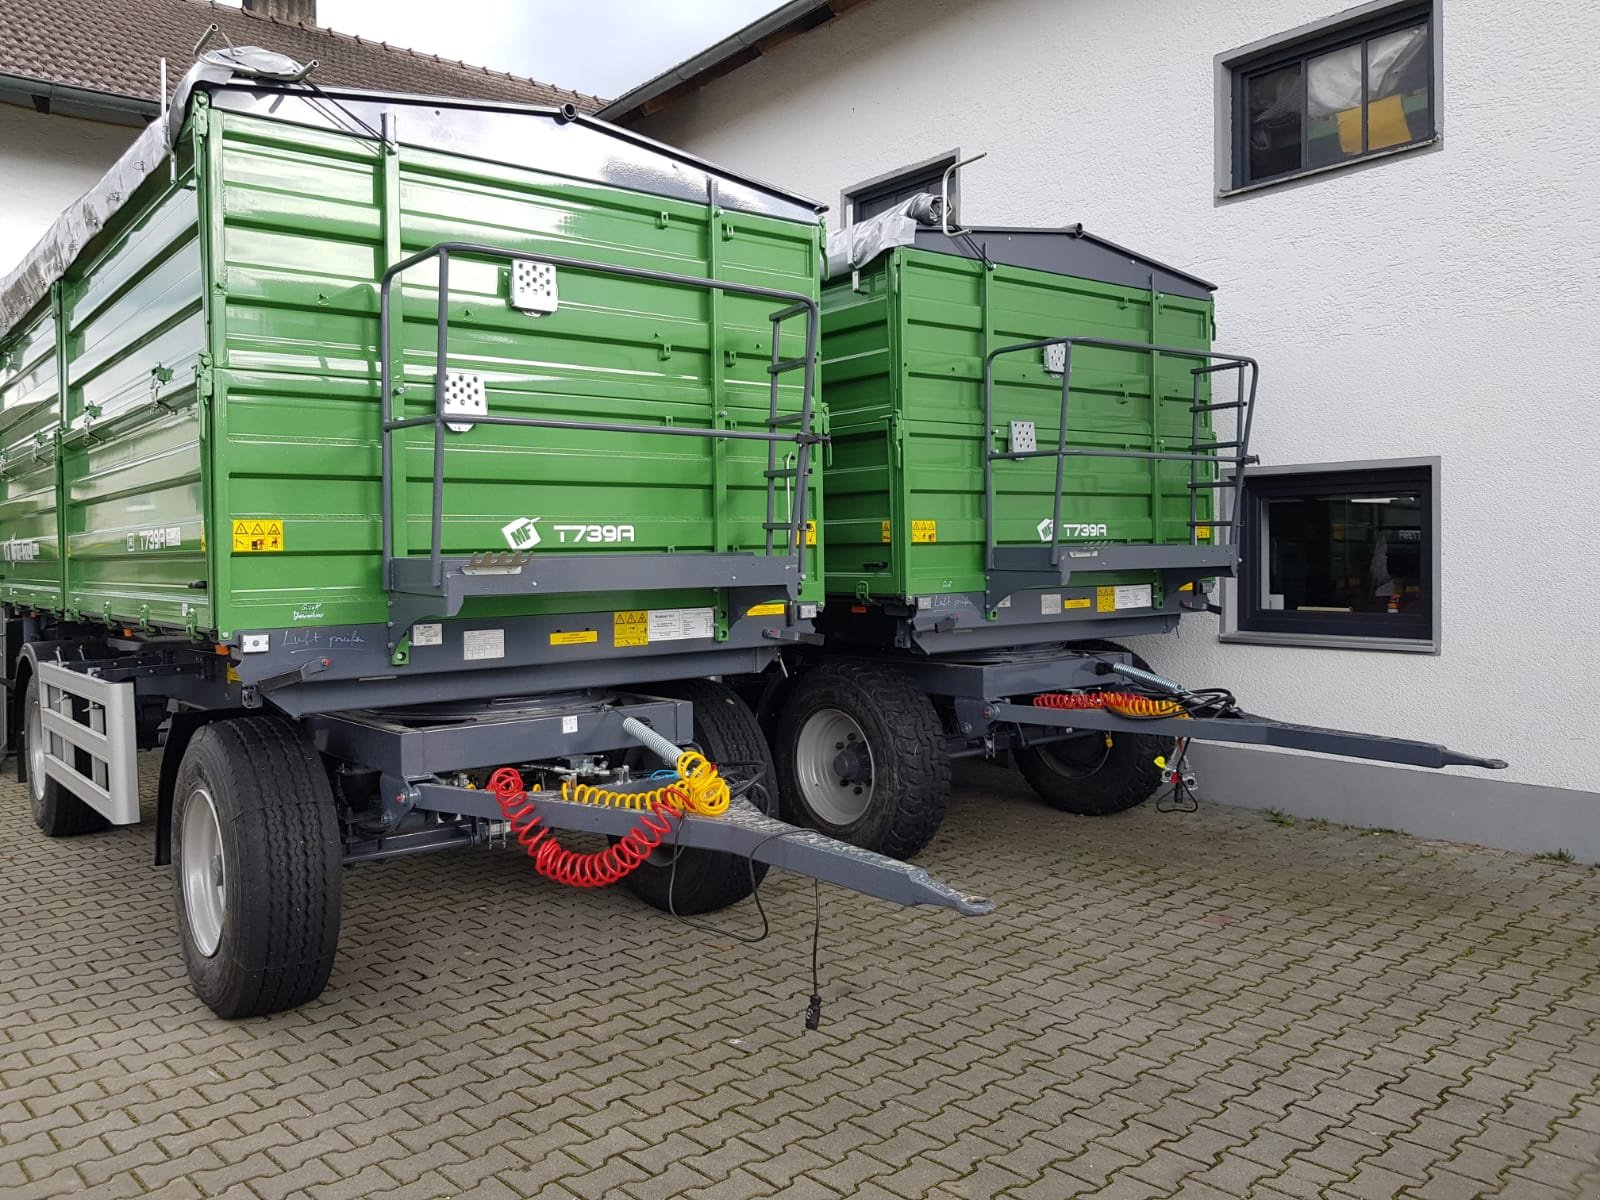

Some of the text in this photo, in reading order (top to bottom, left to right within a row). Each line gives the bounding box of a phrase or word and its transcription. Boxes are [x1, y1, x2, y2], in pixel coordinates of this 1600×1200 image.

[139, 528, 166, 551] T739A
[553, 524, 635, 543] T739A
[1063, 523, 1107, 537] T739A
